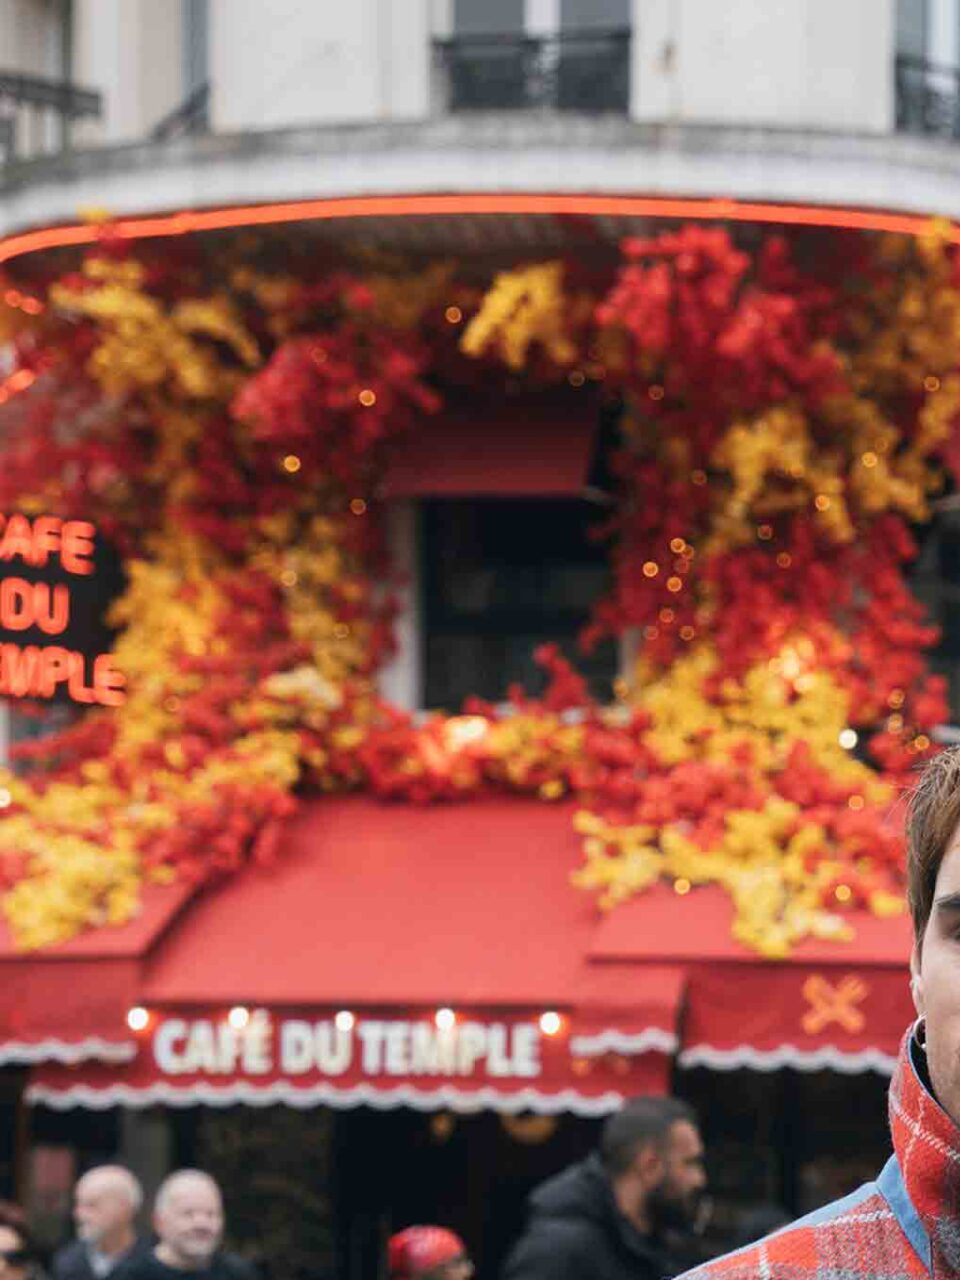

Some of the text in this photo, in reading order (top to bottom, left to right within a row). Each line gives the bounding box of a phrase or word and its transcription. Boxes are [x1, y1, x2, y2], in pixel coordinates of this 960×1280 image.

[0, 512, 95, 575] AFE
[0, 577, 69, 635] DU
[154, 1008, 542, 1078] CAFÉ DU TEMPLE
